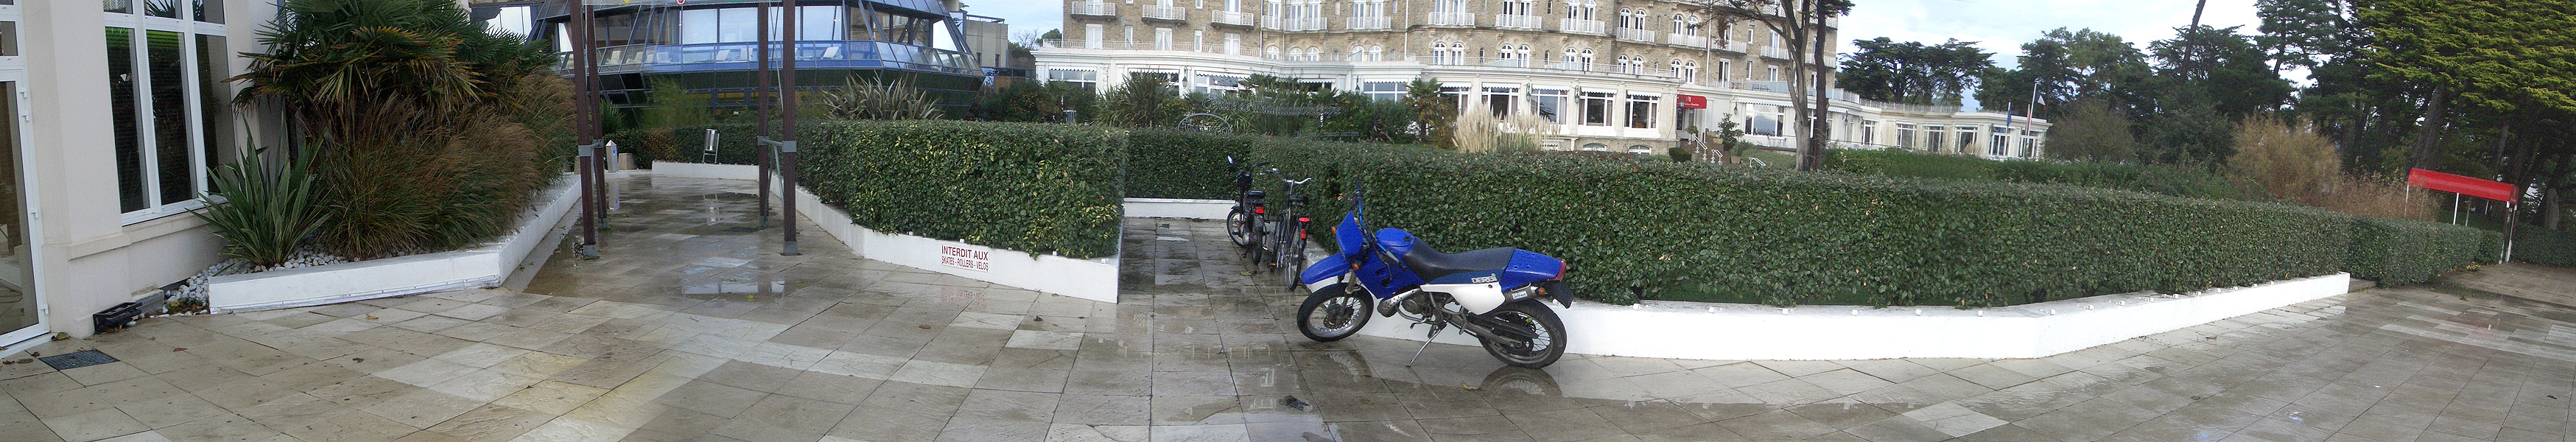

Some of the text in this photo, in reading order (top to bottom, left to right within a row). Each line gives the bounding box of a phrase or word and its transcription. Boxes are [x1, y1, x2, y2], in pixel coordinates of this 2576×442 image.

[1202, 97, 1237, 110] Centre
[1239, 99, 1251, 112] de
[941, 245, 989, 261] INTERDIT AUX
[941, 256, 955, 265] SKATES
[957, 258, 974, 268] ROLLERS
